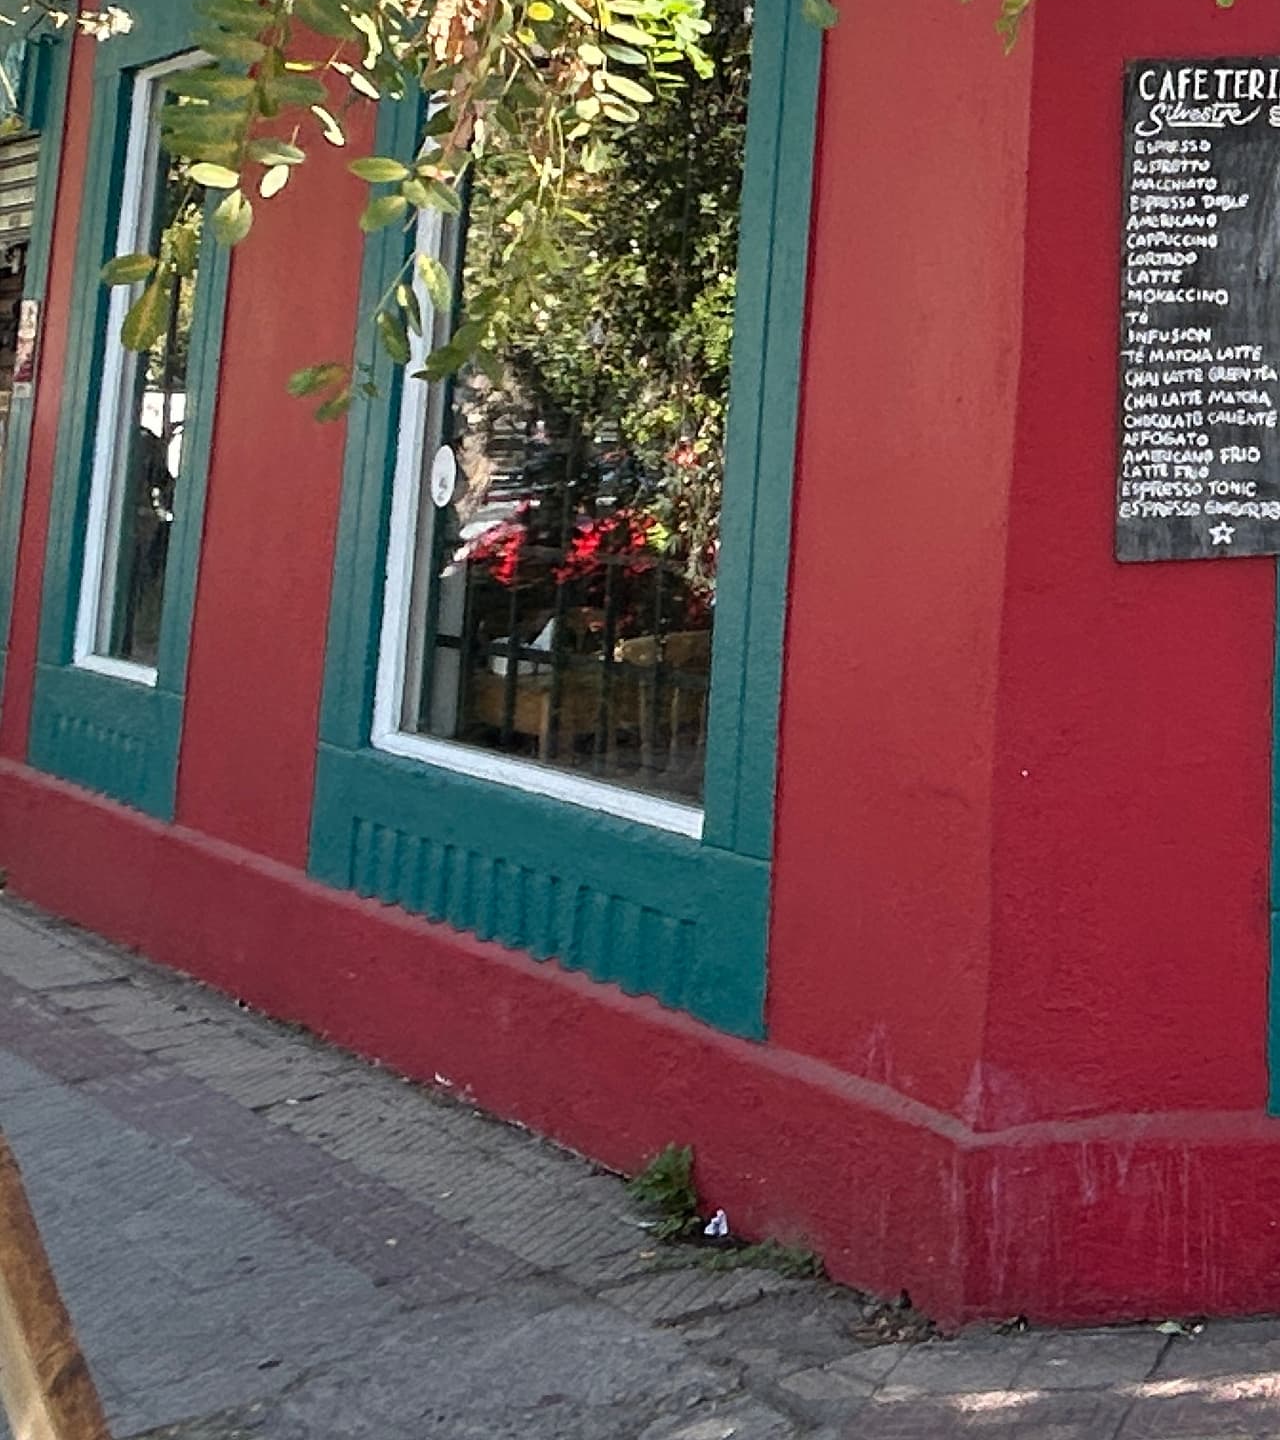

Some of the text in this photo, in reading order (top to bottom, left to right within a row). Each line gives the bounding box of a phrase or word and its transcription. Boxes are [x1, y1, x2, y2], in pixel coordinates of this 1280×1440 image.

[1127, 269, 1183, 285] LATTE
[1128, 289, 1229, 305] MOKACCINO
[1208, 481, 1257, 497] TONIC
